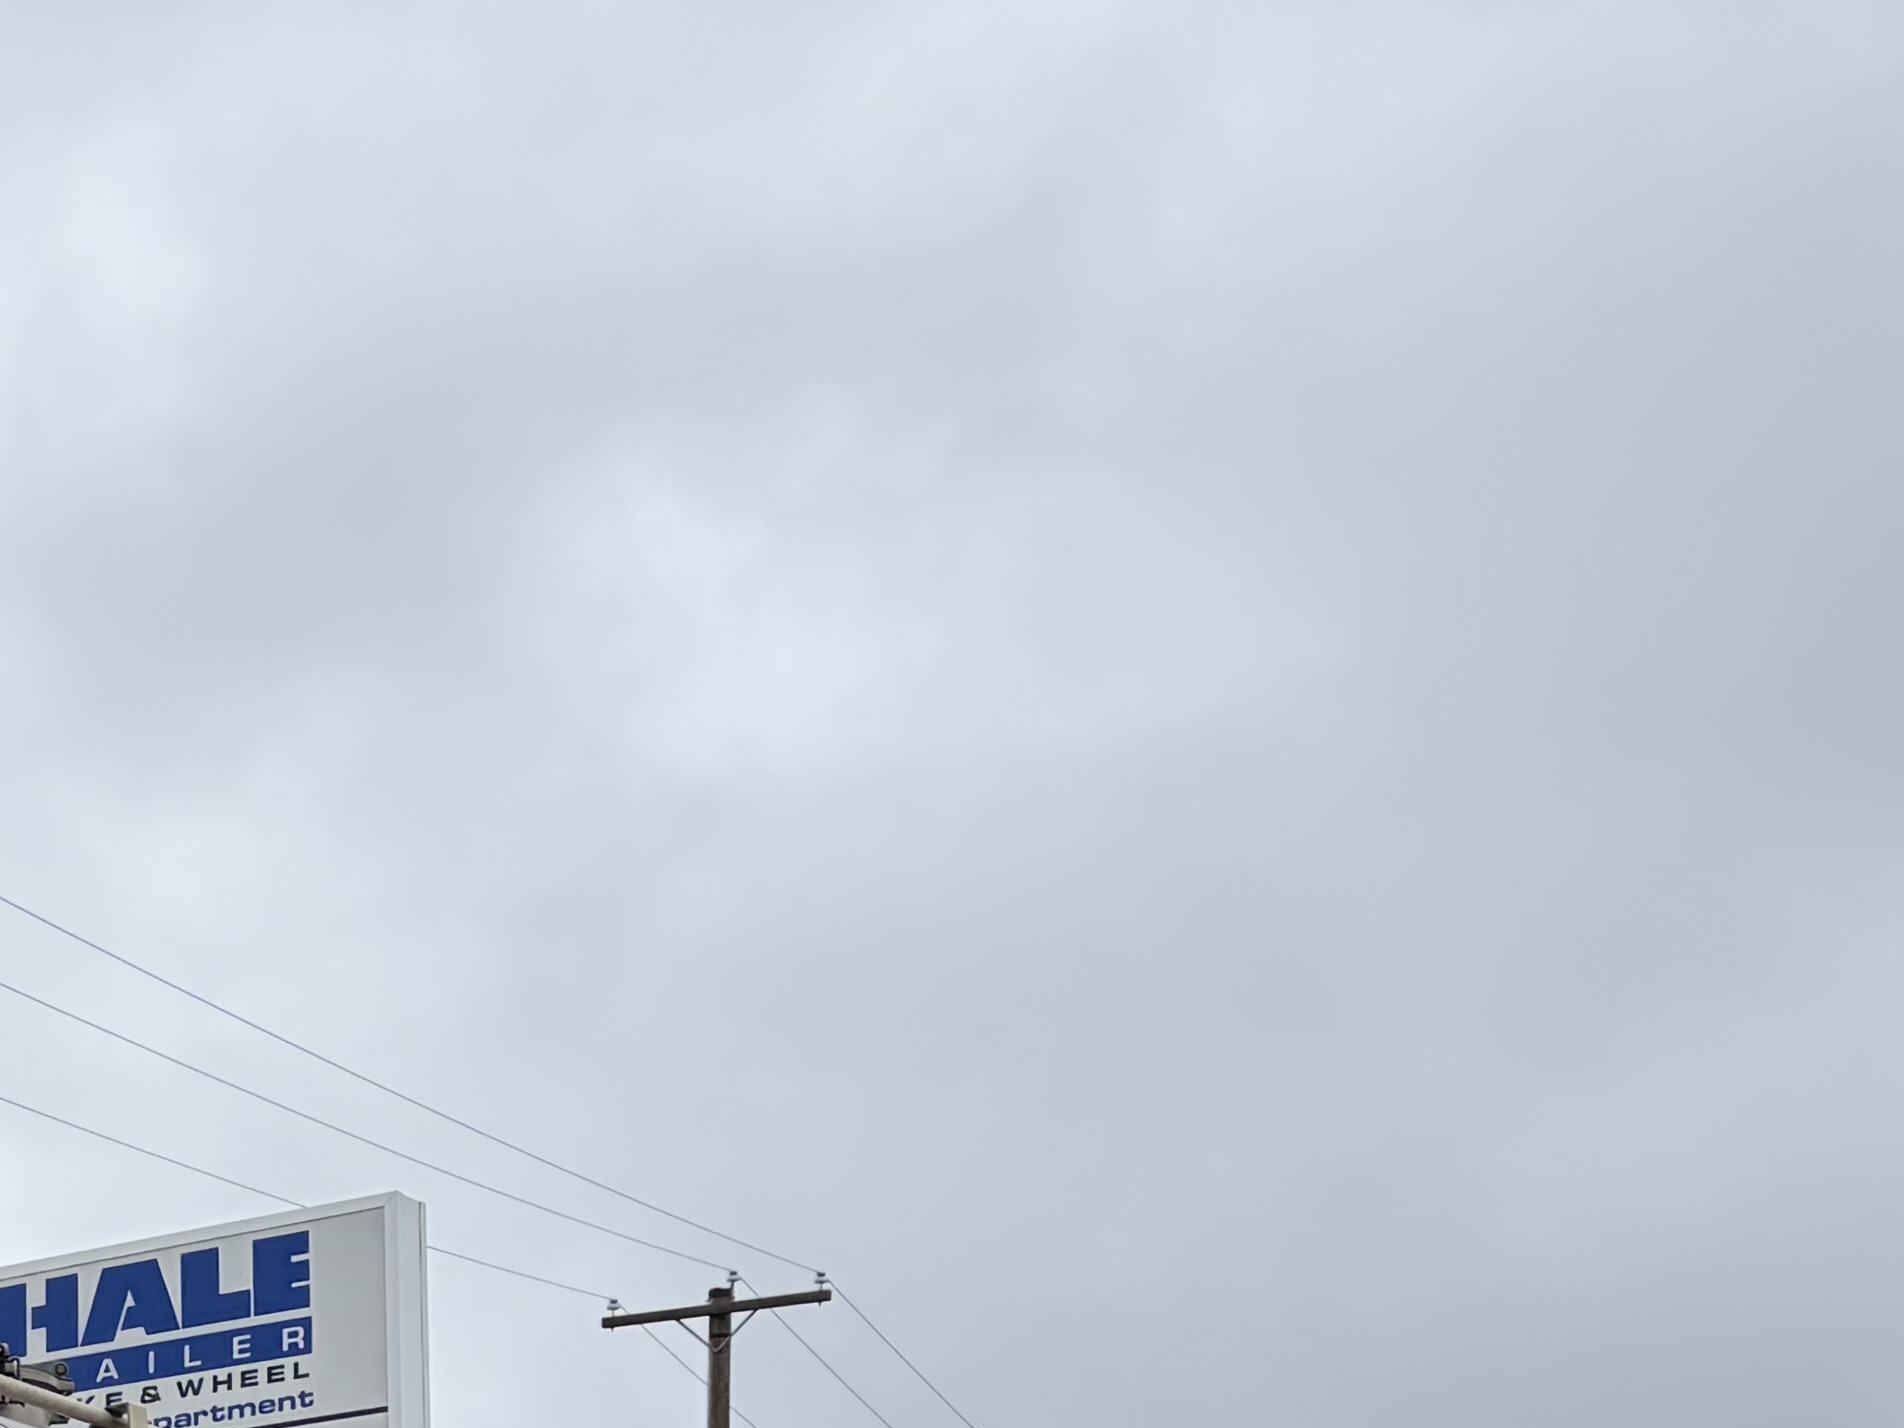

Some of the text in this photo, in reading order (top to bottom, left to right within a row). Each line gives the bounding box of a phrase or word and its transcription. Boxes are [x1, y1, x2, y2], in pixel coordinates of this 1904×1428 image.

[96, 1326, 305, 1383] AILER
[140, 1385, 161, 1404] &
[176, 1361, 310, 1398] WHEEL
